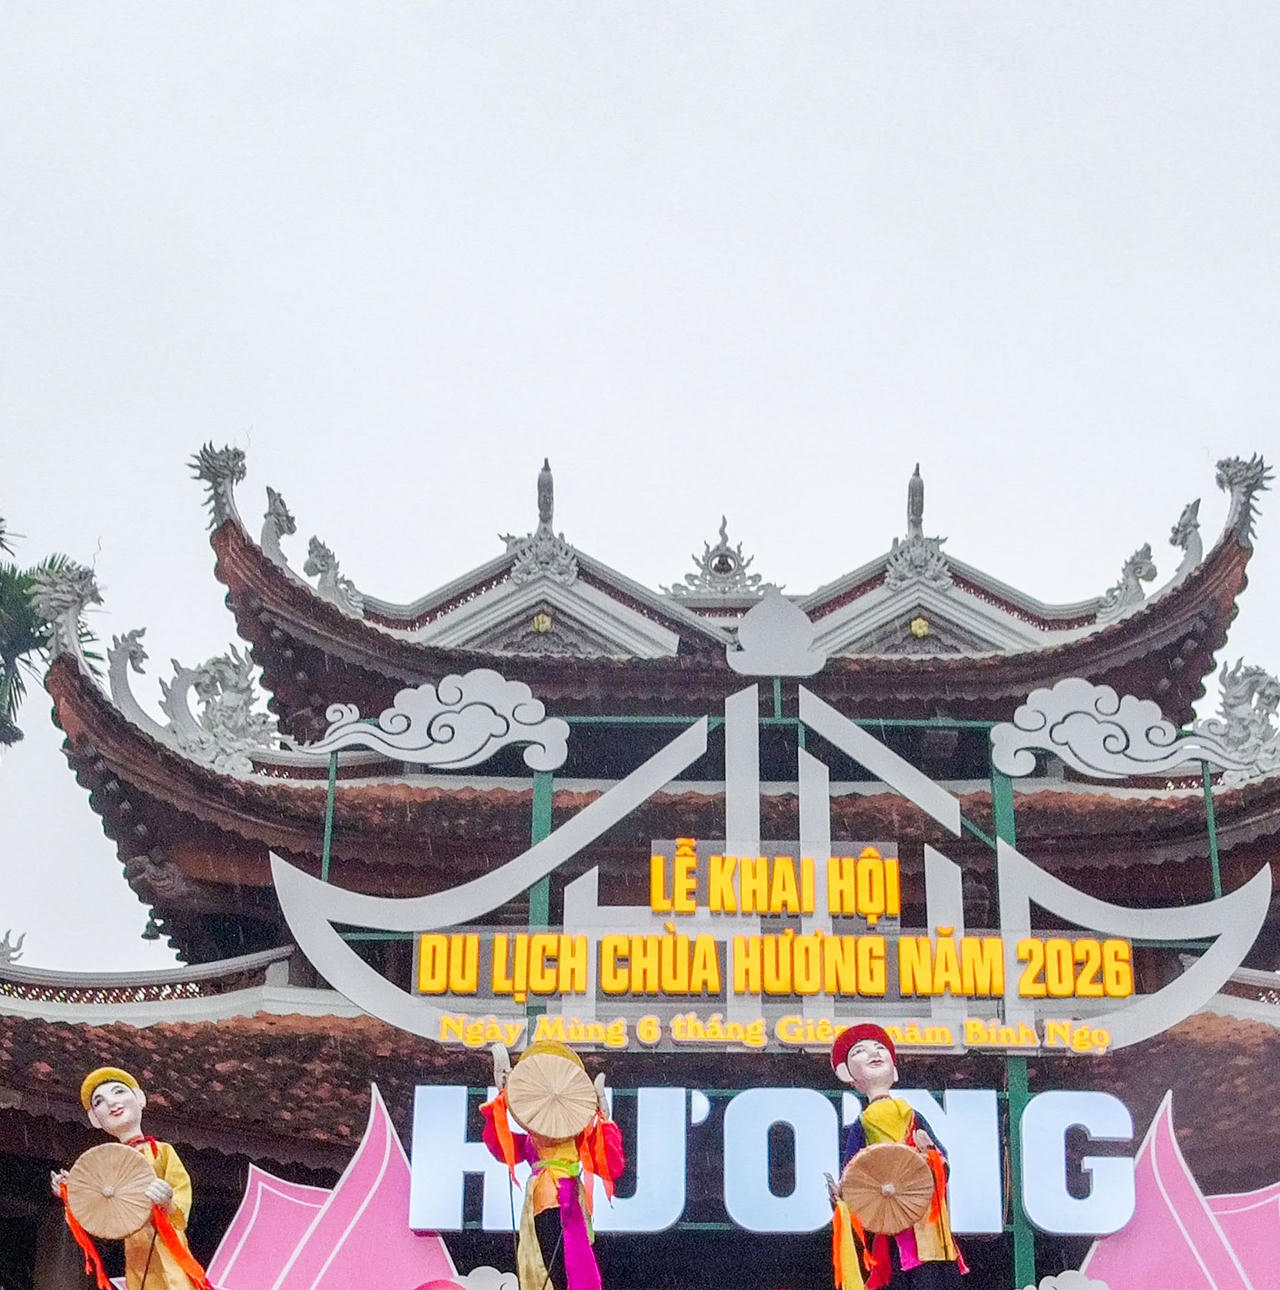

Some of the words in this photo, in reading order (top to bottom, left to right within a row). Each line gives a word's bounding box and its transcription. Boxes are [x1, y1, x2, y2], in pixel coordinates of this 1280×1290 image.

[650, 837, 698, 914] LỄ
[708, 855, 816, 916] KHAI
[826, 846, 901, 926] HỘI
[418, 933, 480, 994] DU
[491, 933, 589, 1004] LỊCH
[600, 921, 722, 995] CHÙA
[732, 927, 888, 996] HƯƠNG
[897, 926, 1006, 998] NĂM
[1016, 937, 1134, 998] 2026
[439, 1014, 523, 1047] Ngày
[534, 1015, 627, 1047] Mùng
[637, 1015, 660, 1043] 6
[671, 1012, 766, 1047] tháng
[775, 1015, 848, 1044] Giê
[962, 1016, 1038, 1046] Bính
[1045, 1020, 1111, 1053] Ngọ
